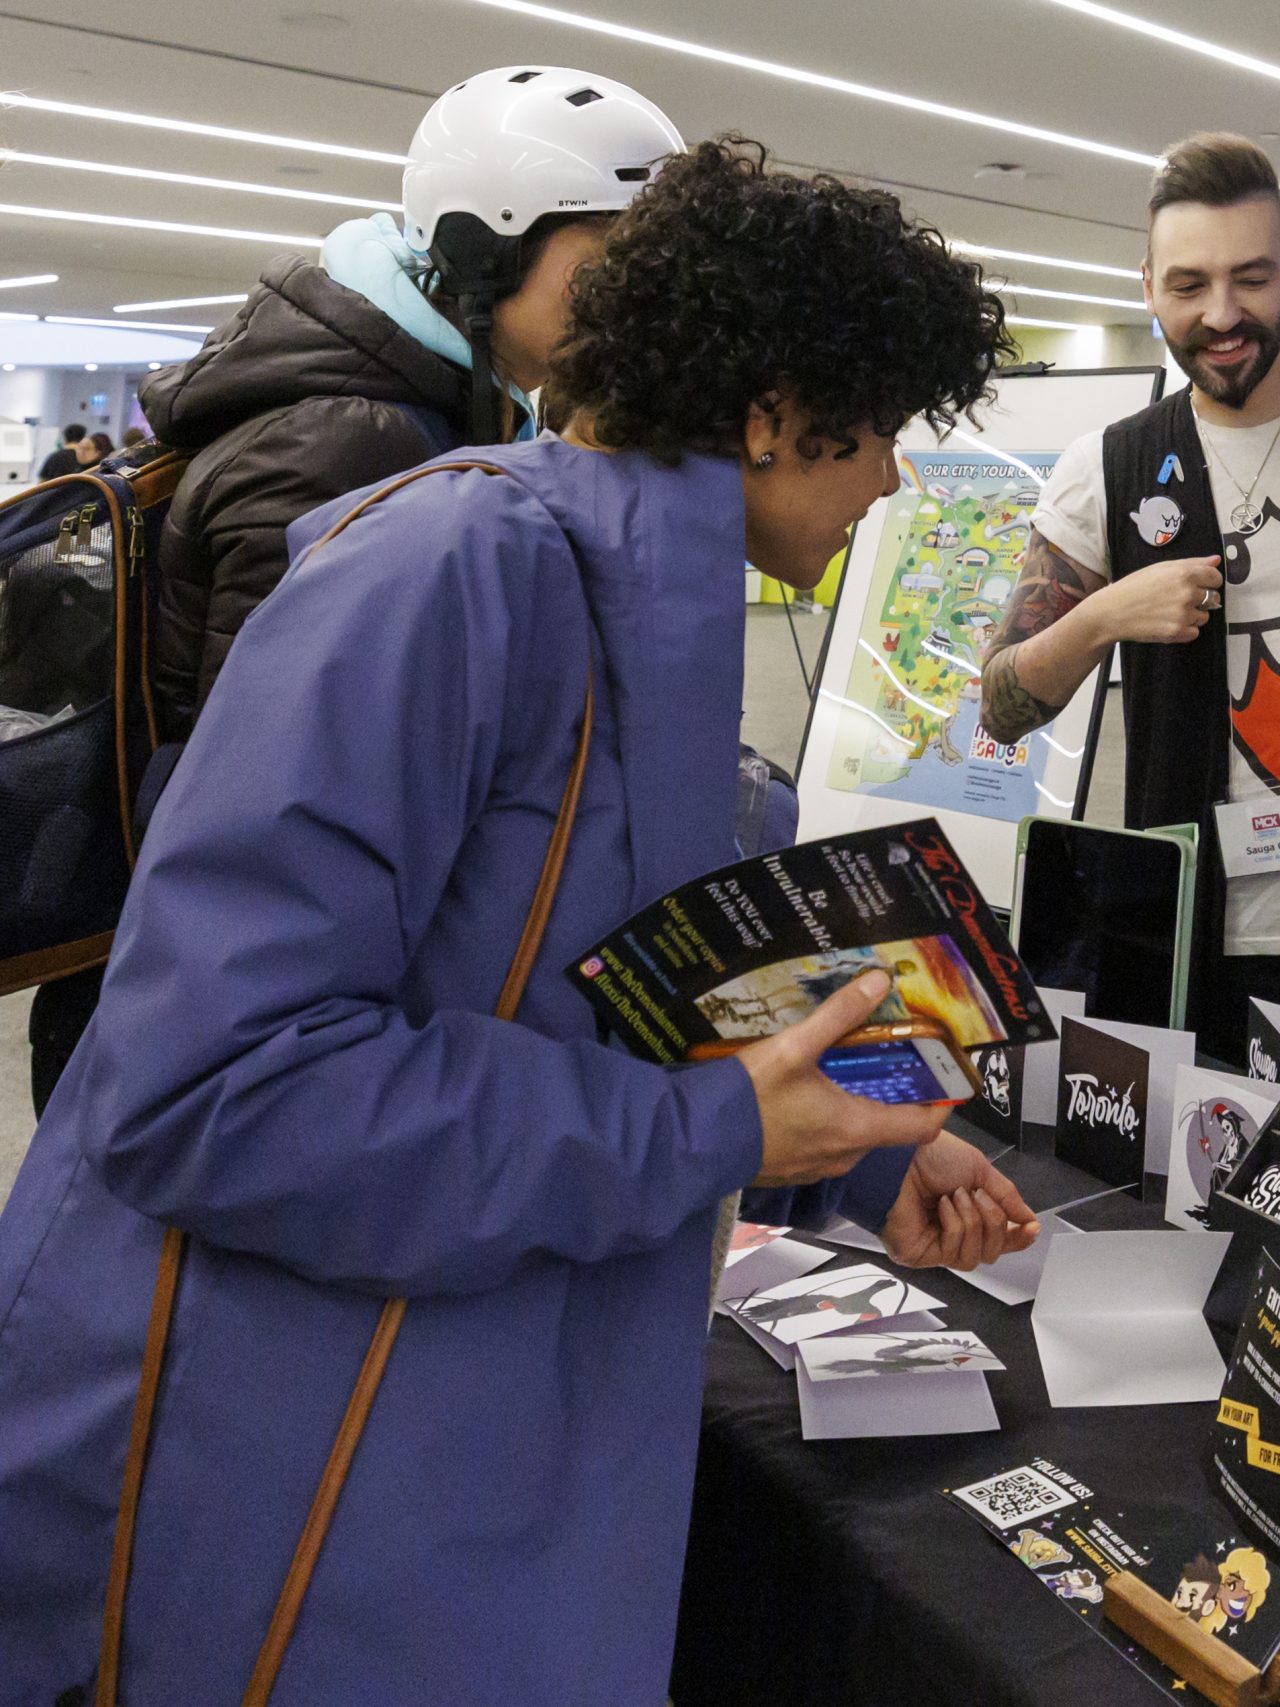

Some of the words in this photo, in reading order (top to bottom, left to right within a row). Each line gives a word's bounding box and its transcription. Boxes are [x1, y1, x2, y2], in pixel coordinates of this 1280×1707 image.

[923, 464, 949, 477] OUR
[951, 464, 979, 480] CITY,
[981, 464, 1015, 478] YOUR
[1017, 464, 1055, 479] CNV
[1246, 843, 1276, 856] Sauga
[827, 854, 846, 874] feel
[838, 872, 850, 885] to
[704, 881, 729, 903] feel
[720, 899, 740, 924] this
[735, 921, 763, 949] way?
[724, 878, 741, 896] Do
[736, 894, 760, 920] YOU
[751, 914, 774, 941] ever
[808, 888, 828, 910] Be
[861, 883, 886, 916] would
[663, 897, 686, 923] Order
[680, 916, 704, 945] your
[699, 939, 727, 974] copies
[1064, 1073, 1142, 1137] Toronto
[1258, 1315, 1277, 1334] great
[1230, 1407, 1243, 1422] YOUR
[1242, 1412, 1254, 1426] ART
[1259, 1448, 1272, 1462] FOR
[1031, 1460, 1078, 1486] FOLLOW
[1069, 1483, 1095, 1500] US!
[1087, 1528, 1100, 1539] ON
[1095, 1536, 1130, 1566] INSTAGRAM
[1092, 1518, 1114, 1537] CHECK
[1109, 1533, 1125, 1546] OUT
[1119, 1544, 1136, 1557] OUR
